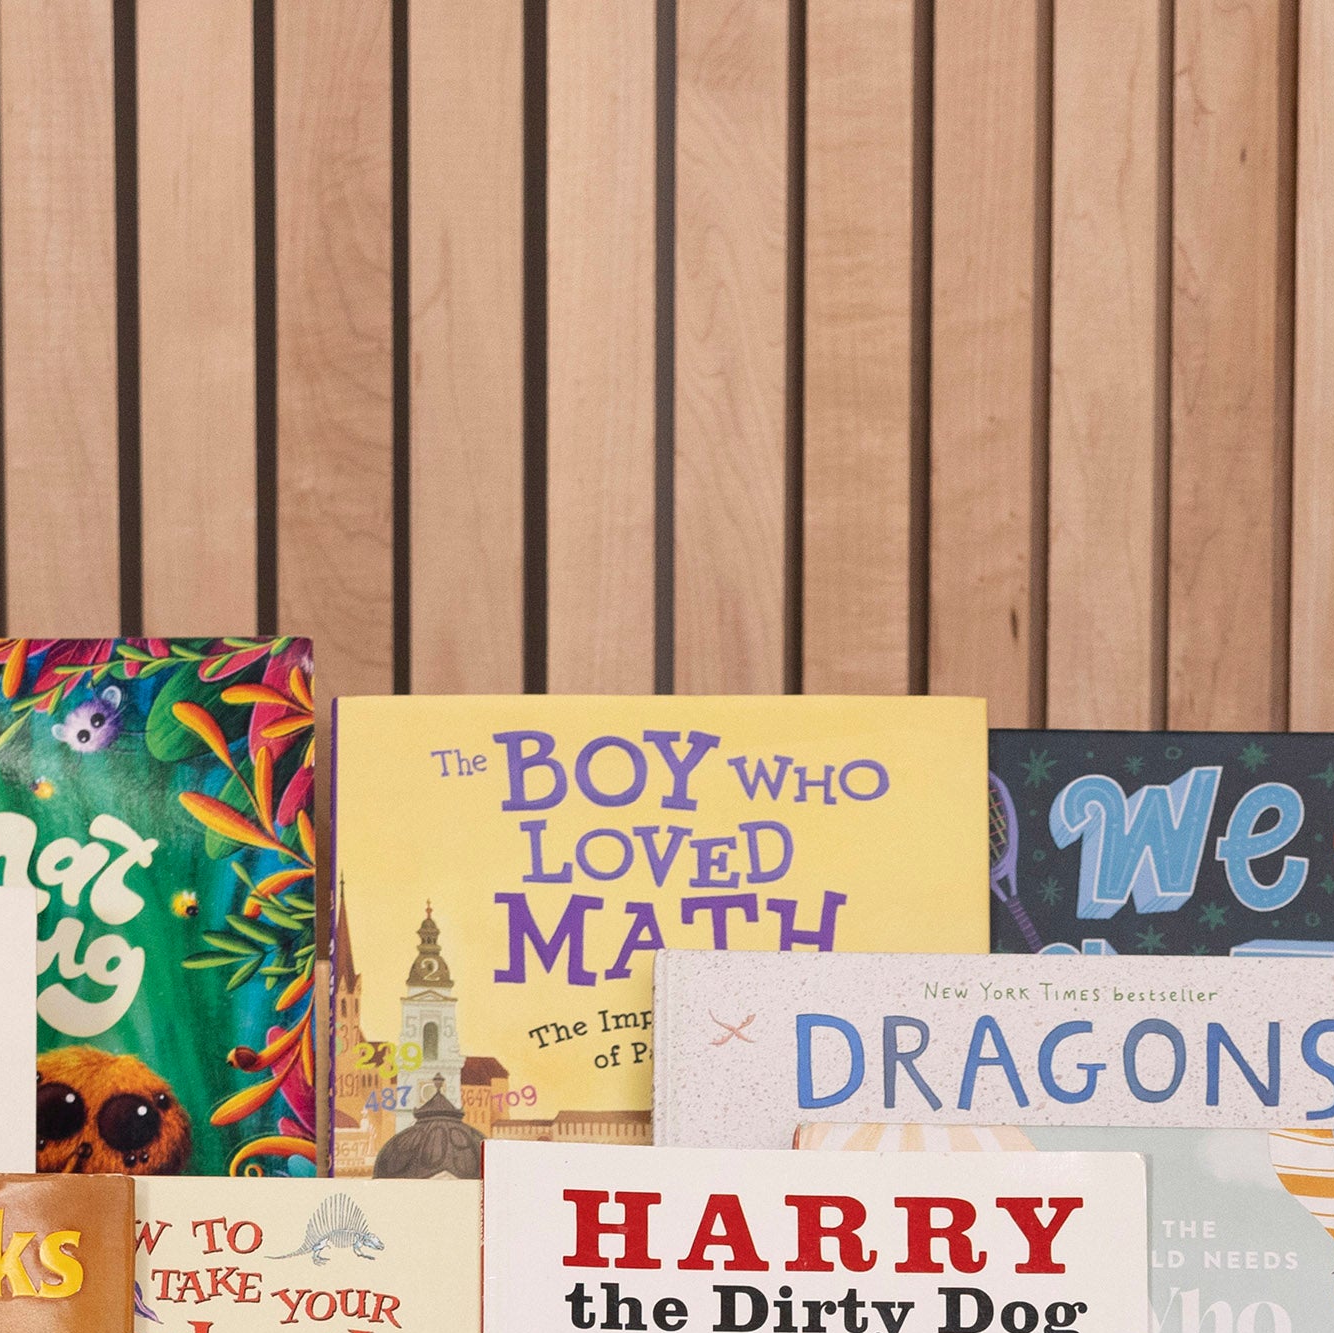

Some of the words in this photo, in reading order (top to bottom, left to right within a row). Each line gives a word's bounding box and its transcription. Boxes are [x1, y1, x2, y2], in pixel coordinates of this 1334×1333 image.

[431, 748, 488, 779] The
[492, 730, 721, 812] BOY
[727, 755, 891, 805] WHO
[519, 819, 794, 889] LOVED
[1049, 766, 1310, 920] We
[493, 890, 848, 986] MATH
[924, 981, 968, 1000] NEW
[979, 981, 1030, 1000] YORK
[1113, 986, 1219, 1002] bestseller
[528, 1020, 588, 1049] The
[598, 1009, 653, 1033] Imp
[353, 1042, 423, 1079] 239
[594, 1044, 621, 1069] of
[364, 1086, 413, 1112] 487
[491, 1085, 538, 1113] 709
[192, 1217, 263, 1255] TO
[562, 1188, 1084, 1275] HARRY
[1162, 1220, 1217, 1239] THE
[1203, 1251, 1299, 1270] NEEDS
[151, 1266, 263, 1304] TAKE
[270, 1288, 403, 1328] YOUR
[564, 1281, 689, 1333] the
